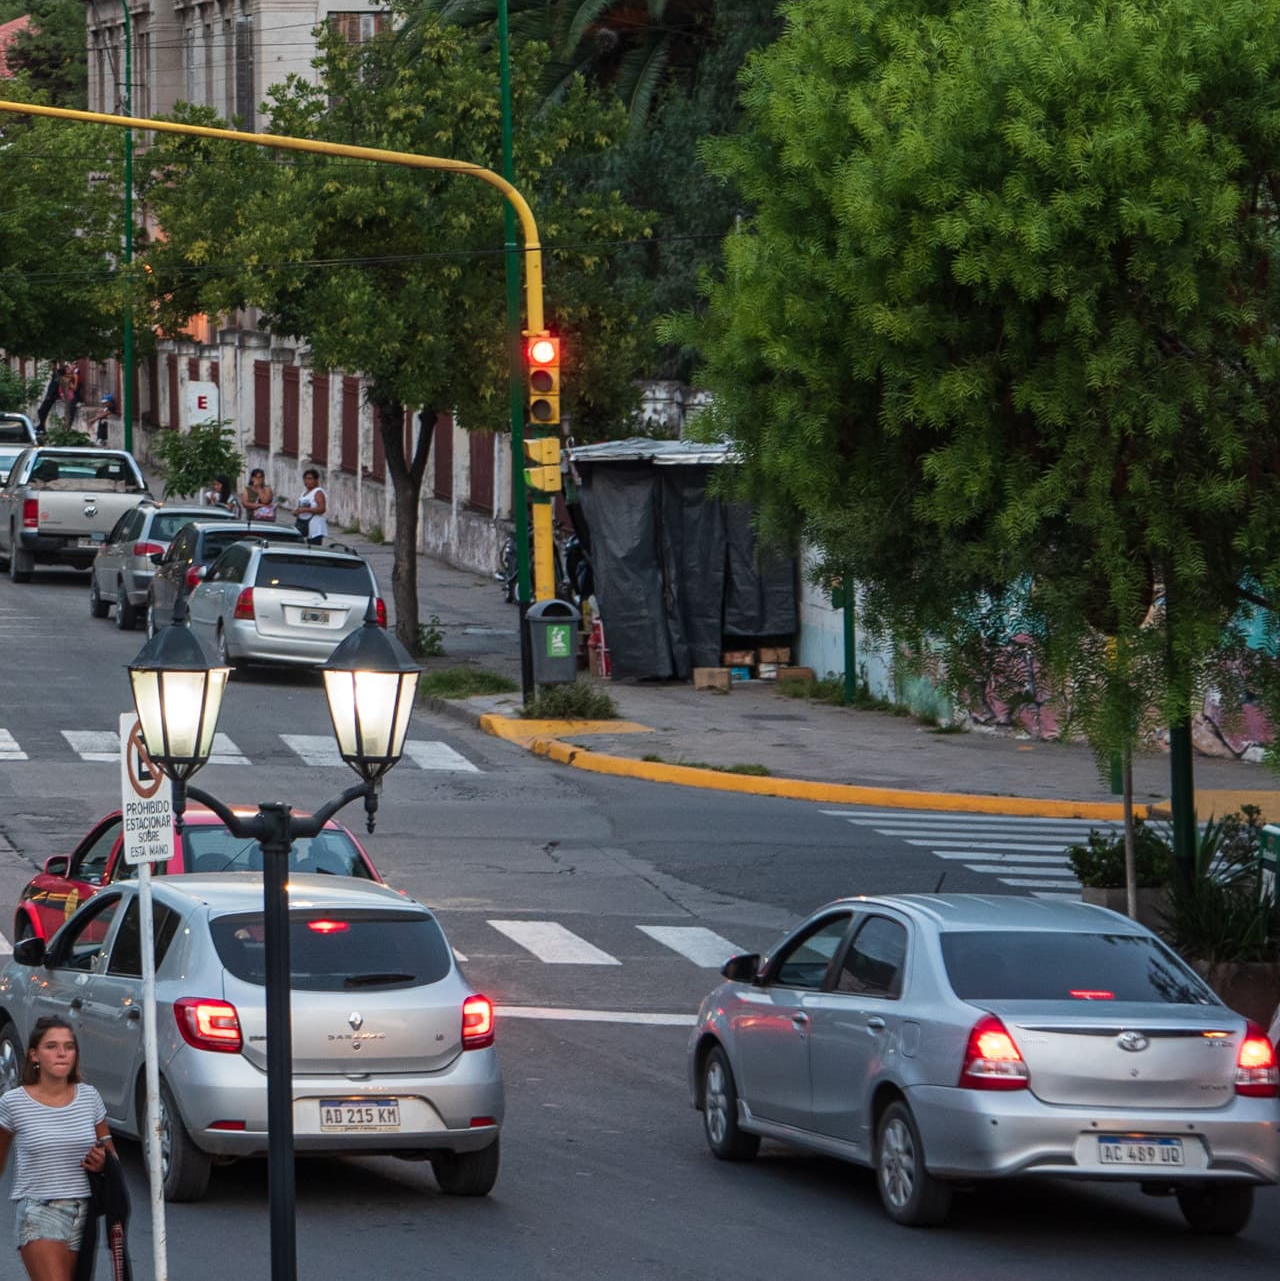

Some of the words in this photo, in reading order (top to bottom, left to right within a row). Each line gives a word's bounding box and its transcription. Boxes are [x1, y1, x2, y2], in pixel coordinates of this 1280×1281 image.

[197, 395, 209, 410] E
[126, 800, 170, 816] PROHIBIDO
[126, 815, 171, 831] ESTACIONAR
[138, 830, 160, 843] SOBRE
[130, 846, 146, 858] ESTA
[149, 844, 169, 856] MANO
[325, 1109, 343, 1124] AD
[347, 1109, 374, 1124] 215
[378, 1108, 397, 1123] KM
[1104, 1145, 1122, 1161] AC
